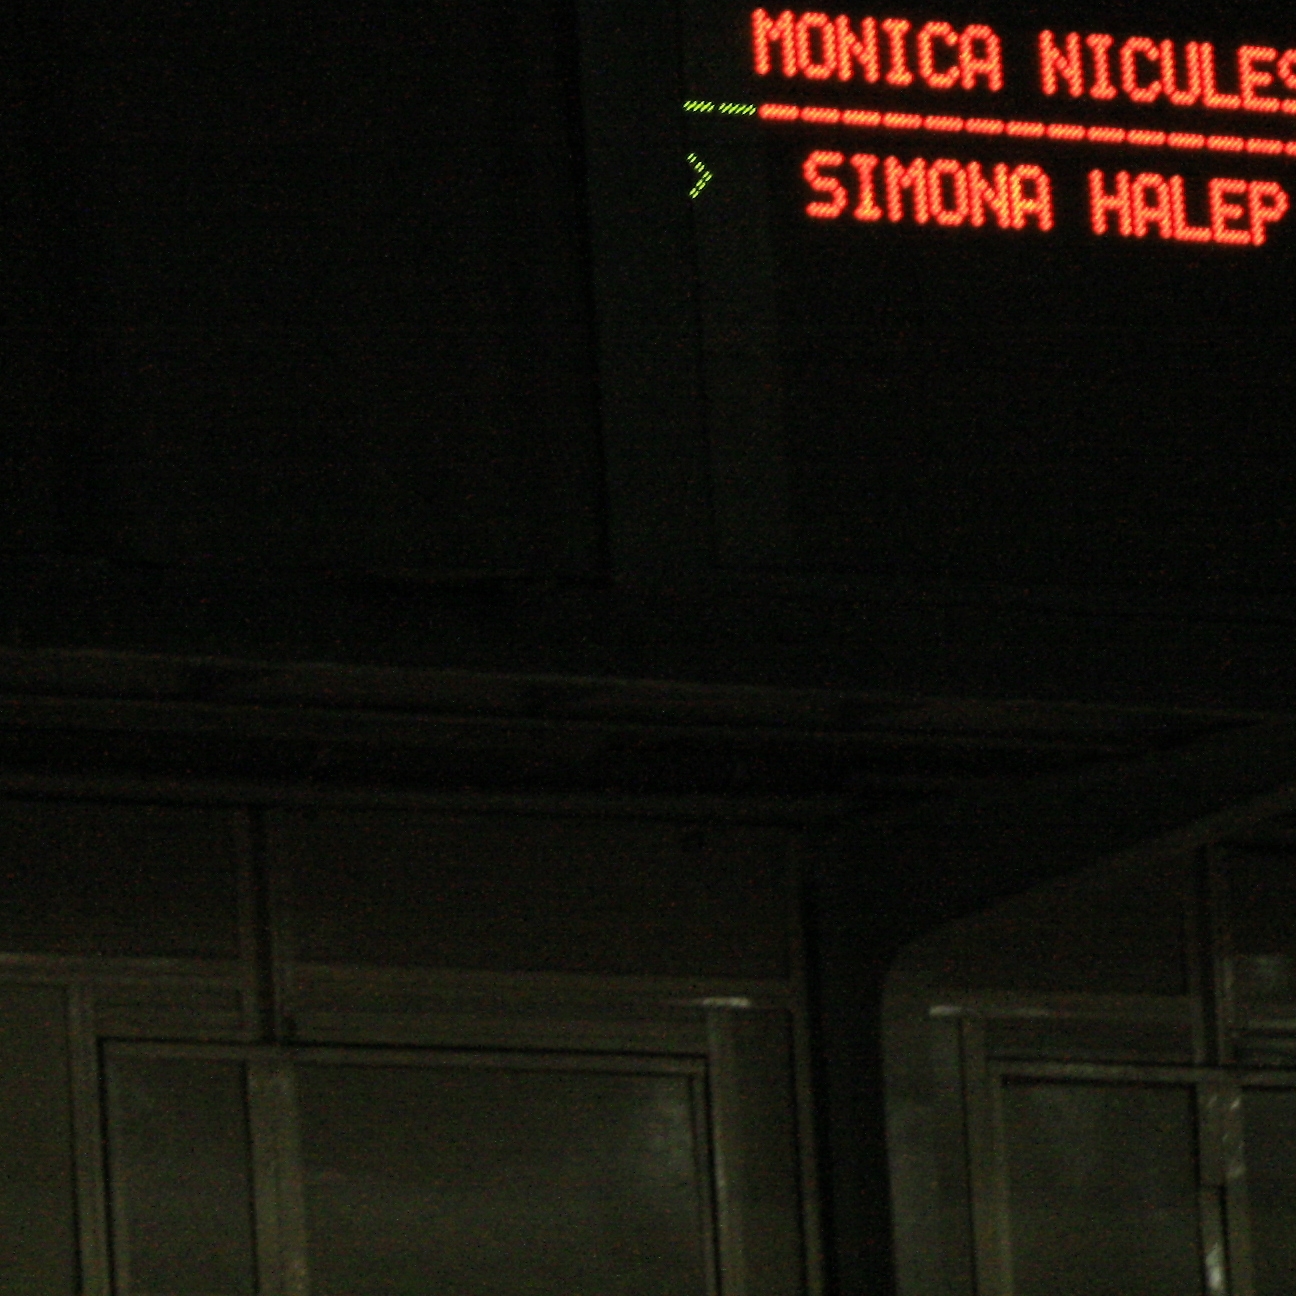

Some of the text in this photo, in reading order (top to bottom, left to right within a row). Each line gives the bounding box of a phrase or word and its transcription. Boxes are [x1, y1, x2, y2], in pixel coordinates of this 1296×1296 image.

[750, 7, 1005, 93] MONICA
[801, 149, 1291, 247] SIMONA HALEP
